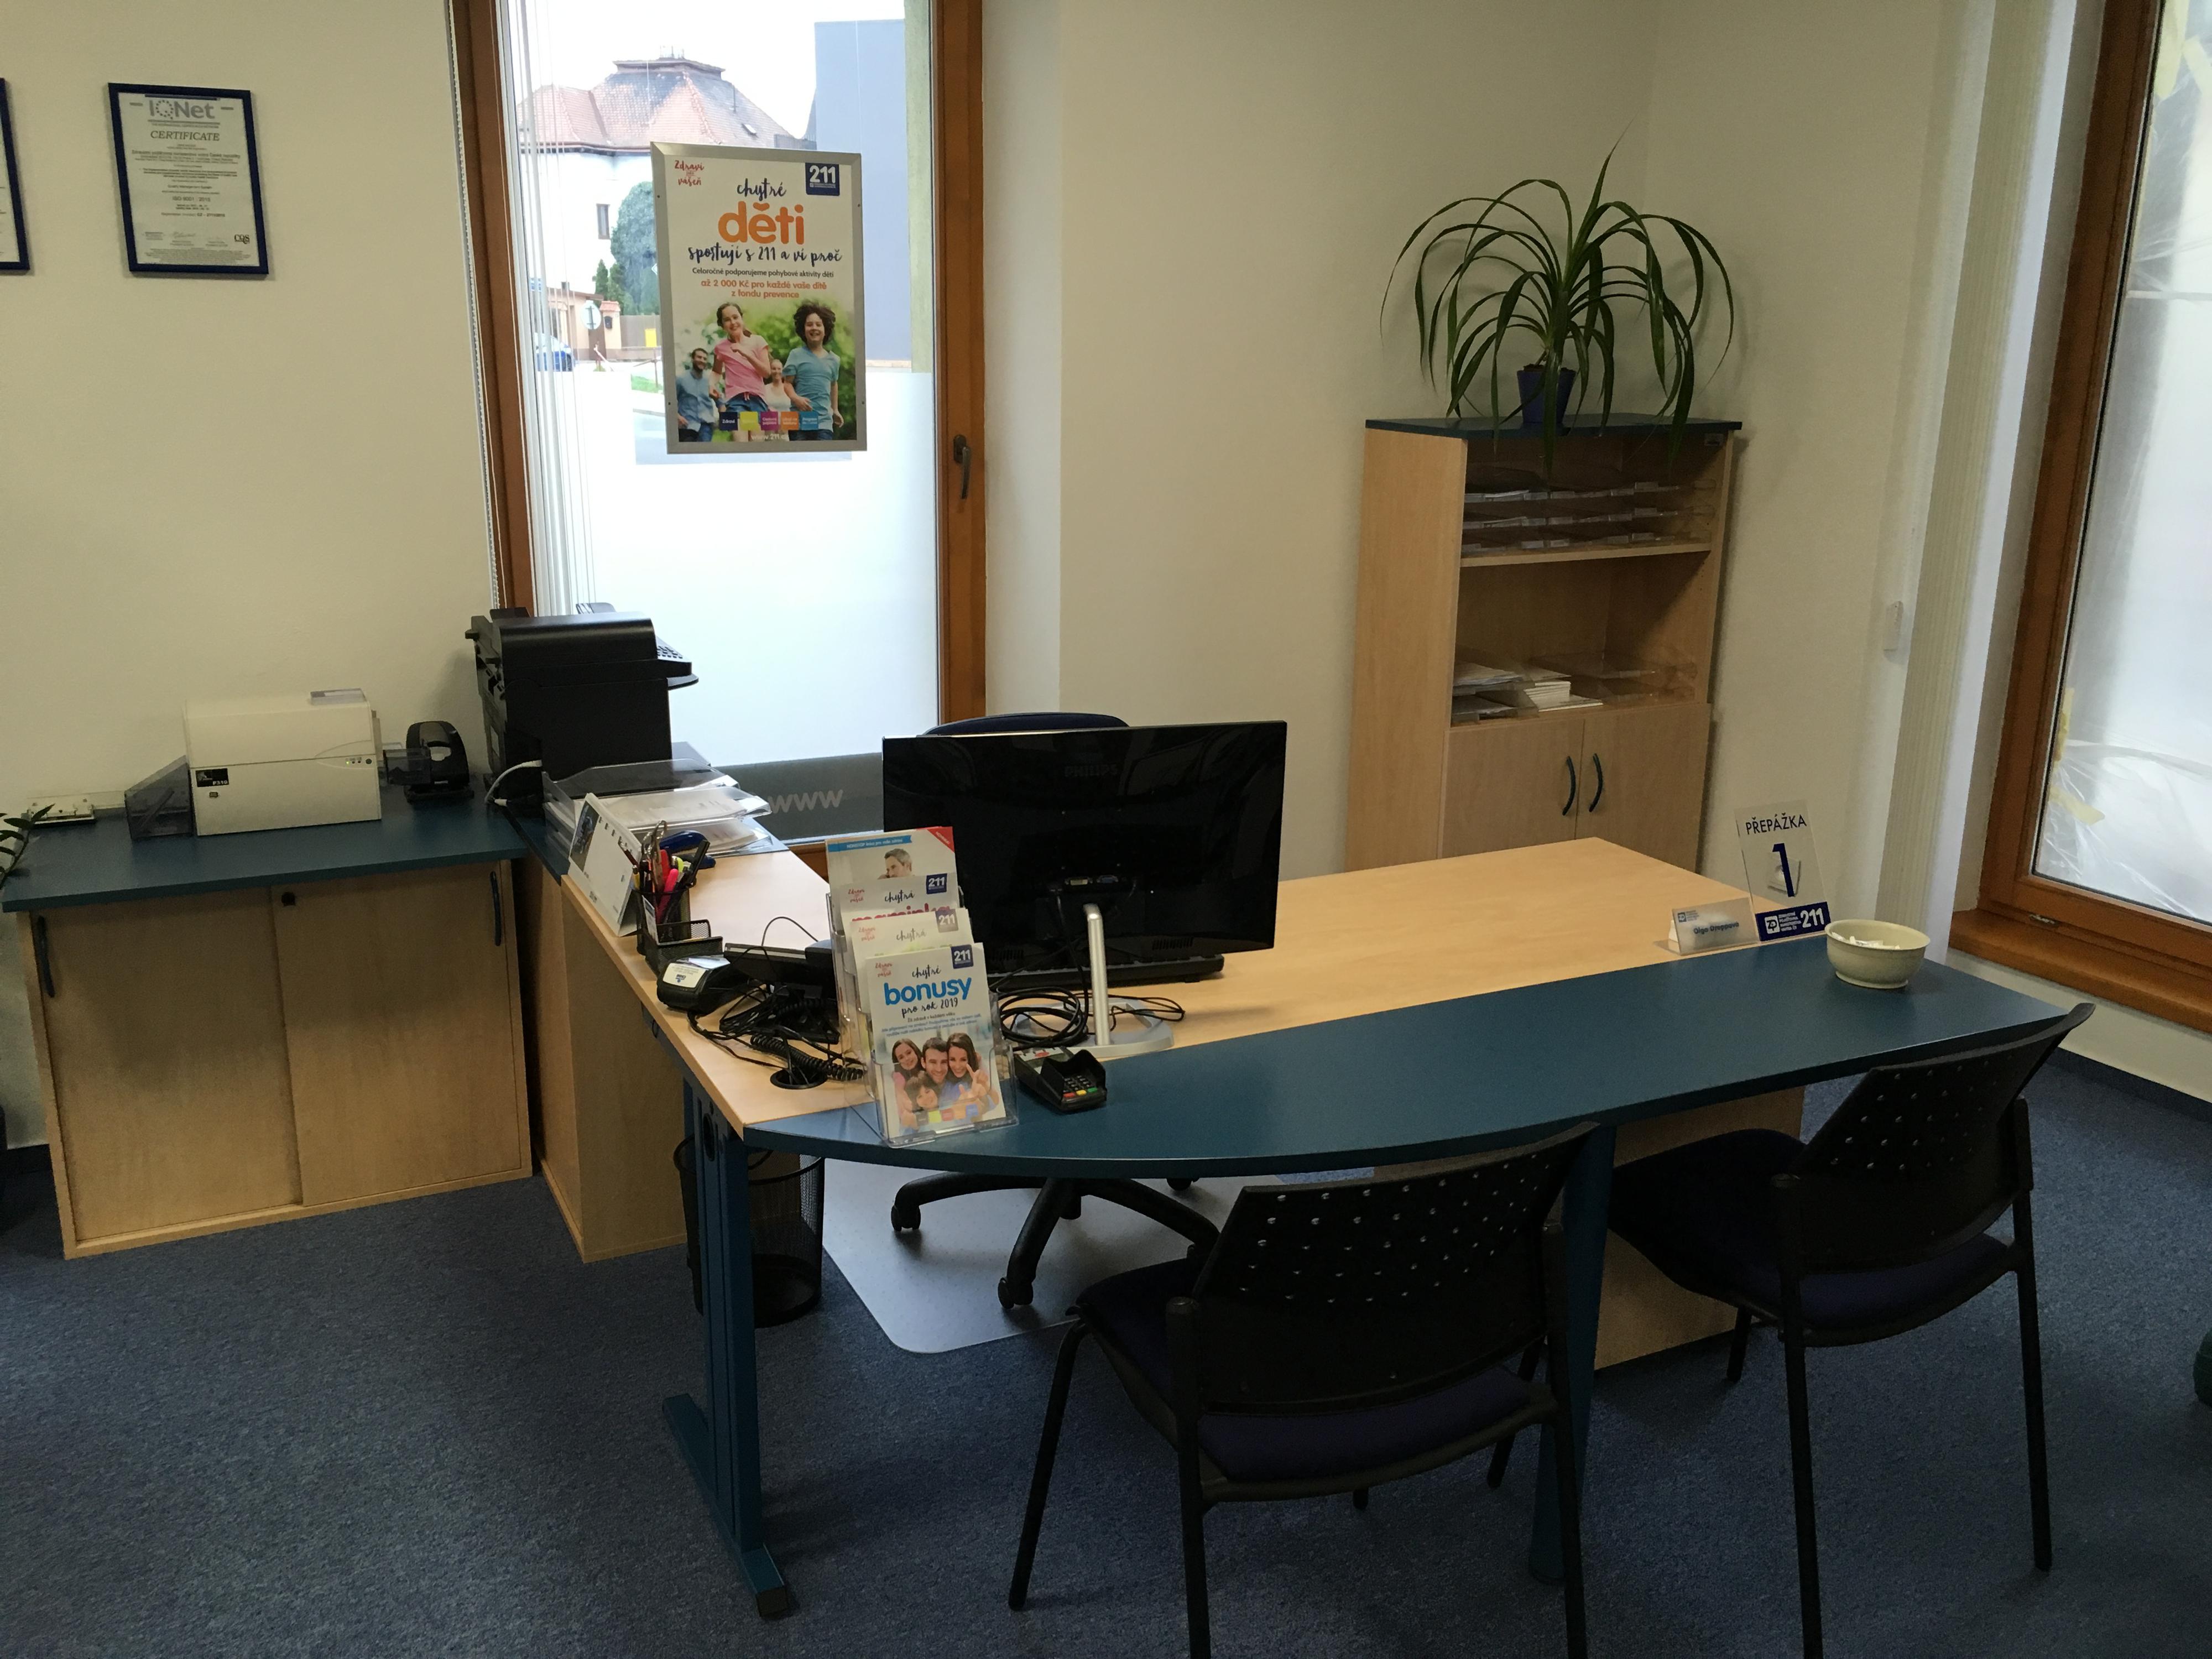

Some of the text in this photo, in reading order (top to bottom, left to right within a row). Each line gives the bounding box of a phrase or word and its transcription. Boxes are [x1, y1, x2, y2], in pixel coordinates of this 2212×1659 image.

[150, 130, 220, 142] CERTIFICATE
[809, 165, 836, 184] 211
[737, 178, 786, 201] chytré
[718, 200, 805, 245] děti
[688, 242, 743, 265] sportují
[745, 247, 755, 262] s
[758, 246, 775, 260] 211
[780, 249, 790, 260] a
[811, 249, 843, 267] proč
[725, 268, 767, 277] podporujeme
[768, 269, 798, 278] pohybové
[800, 270, 821, 279] aktivity
[701, 279, 711, 287] až
[739, 279, 749, 288] Kč
[751, 281, 765, 290] pro
[766, 280, 791, 289] každé
[738, 289, 761, 298] fondu
[763, 291, 800, 299] prevence
[1745, 812, 1807, 836] PŘEPÁŽKA
[1772, 842, 1795, 898] 1
[928, 877, 945, 888] 211
[885, 889, 915, 904] chytrá
[938, 913, 956, 926] 211
[1800, 907, 1824, 928] 211
[896, 927, 927, 942] chytrá
[953, 949, 971, 962] 211
[912, 964, 942, 979] chytré
[884, 977, 972, 1006] bonusy
[901, 997, 959, 1019] pro rok 2019
